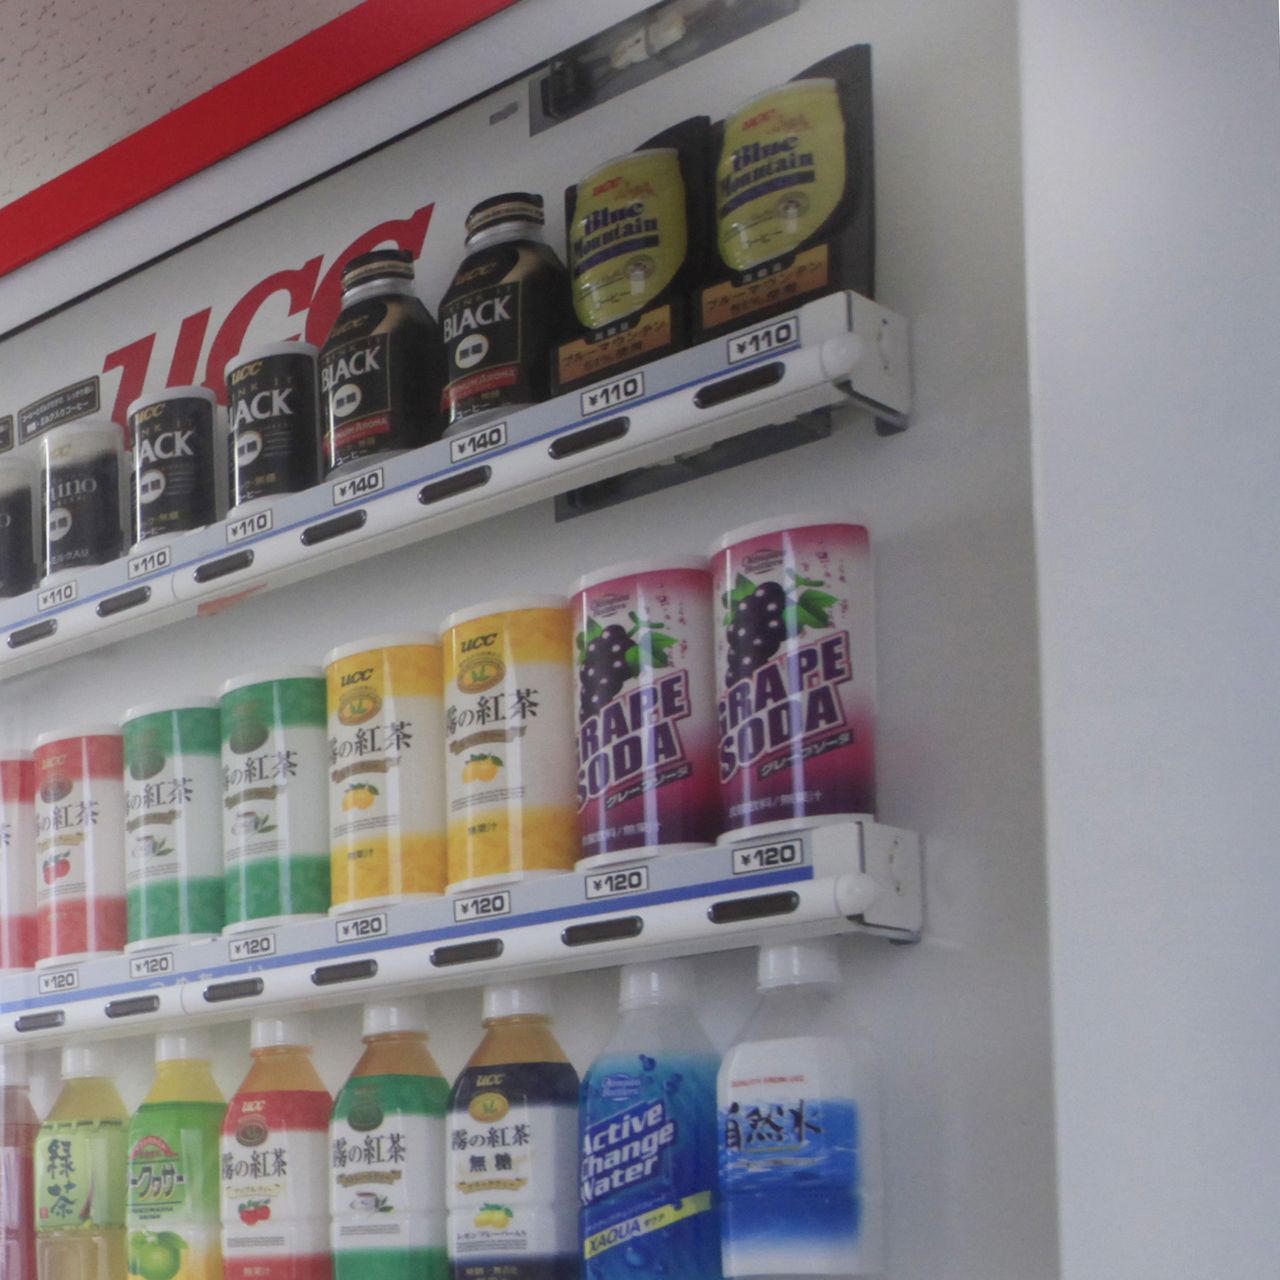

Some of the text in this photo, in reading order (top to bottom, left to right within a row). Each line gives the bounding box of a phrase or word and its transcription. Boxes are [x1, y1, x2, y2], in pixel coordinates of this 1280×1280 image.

[443, 294, 512, 344] BLACK
[736, 322, 792, 355] ¥110
[321, 345, 381, 393] BLACK
[588, 378, 639, 406] ¥110
[456, 426, 502, 455] ¥140
[339, 471, 380, 497] ¥140
[230, 513, 268, 537] ¥110
[132, 556, 168, 574] ¥110
[41, 584, 74, 605] ¥110
[460, 632, 498, 653] UCC
[340, 668, 374, 688] UCC
[720, 632, 850, 738] RAPE
[580, 670, 690, 762] RAPE
[720, 686, 842, 785] SODA
[37, 800, 100, 834] の紅茶
[739, 842, 798, 868] ¥120
[592, 871, 644, 893] ¥120
[460, 895, 505, 915] ¥120
[341, 917, 383, 937] ¥120
[233, 938, 271, 955] ¥120
[134, 957, 170, 975] ¥120
[43, 973, 75, 989] ¥120
[476, 1073, 506, 1087] UCC
[241, 1099, 267, 1113] UCC
[451, 1123, 532, 1152] 霧の紅茶
[584, 1103, 663, 1157] Active
[724, 1098, 824, 1151] 自然水
[221, 1147, 289, 1181] 霧の紅茶
[332, 1132, 408, 1170] 霧の紅茶
[468, 1153, 514, 1173] 無糖
[46, 1137, 78, 1219] 緑茶
[581, 1154, 658, 1206] Water
[589, 1217, 641, 1252] XAQUA
